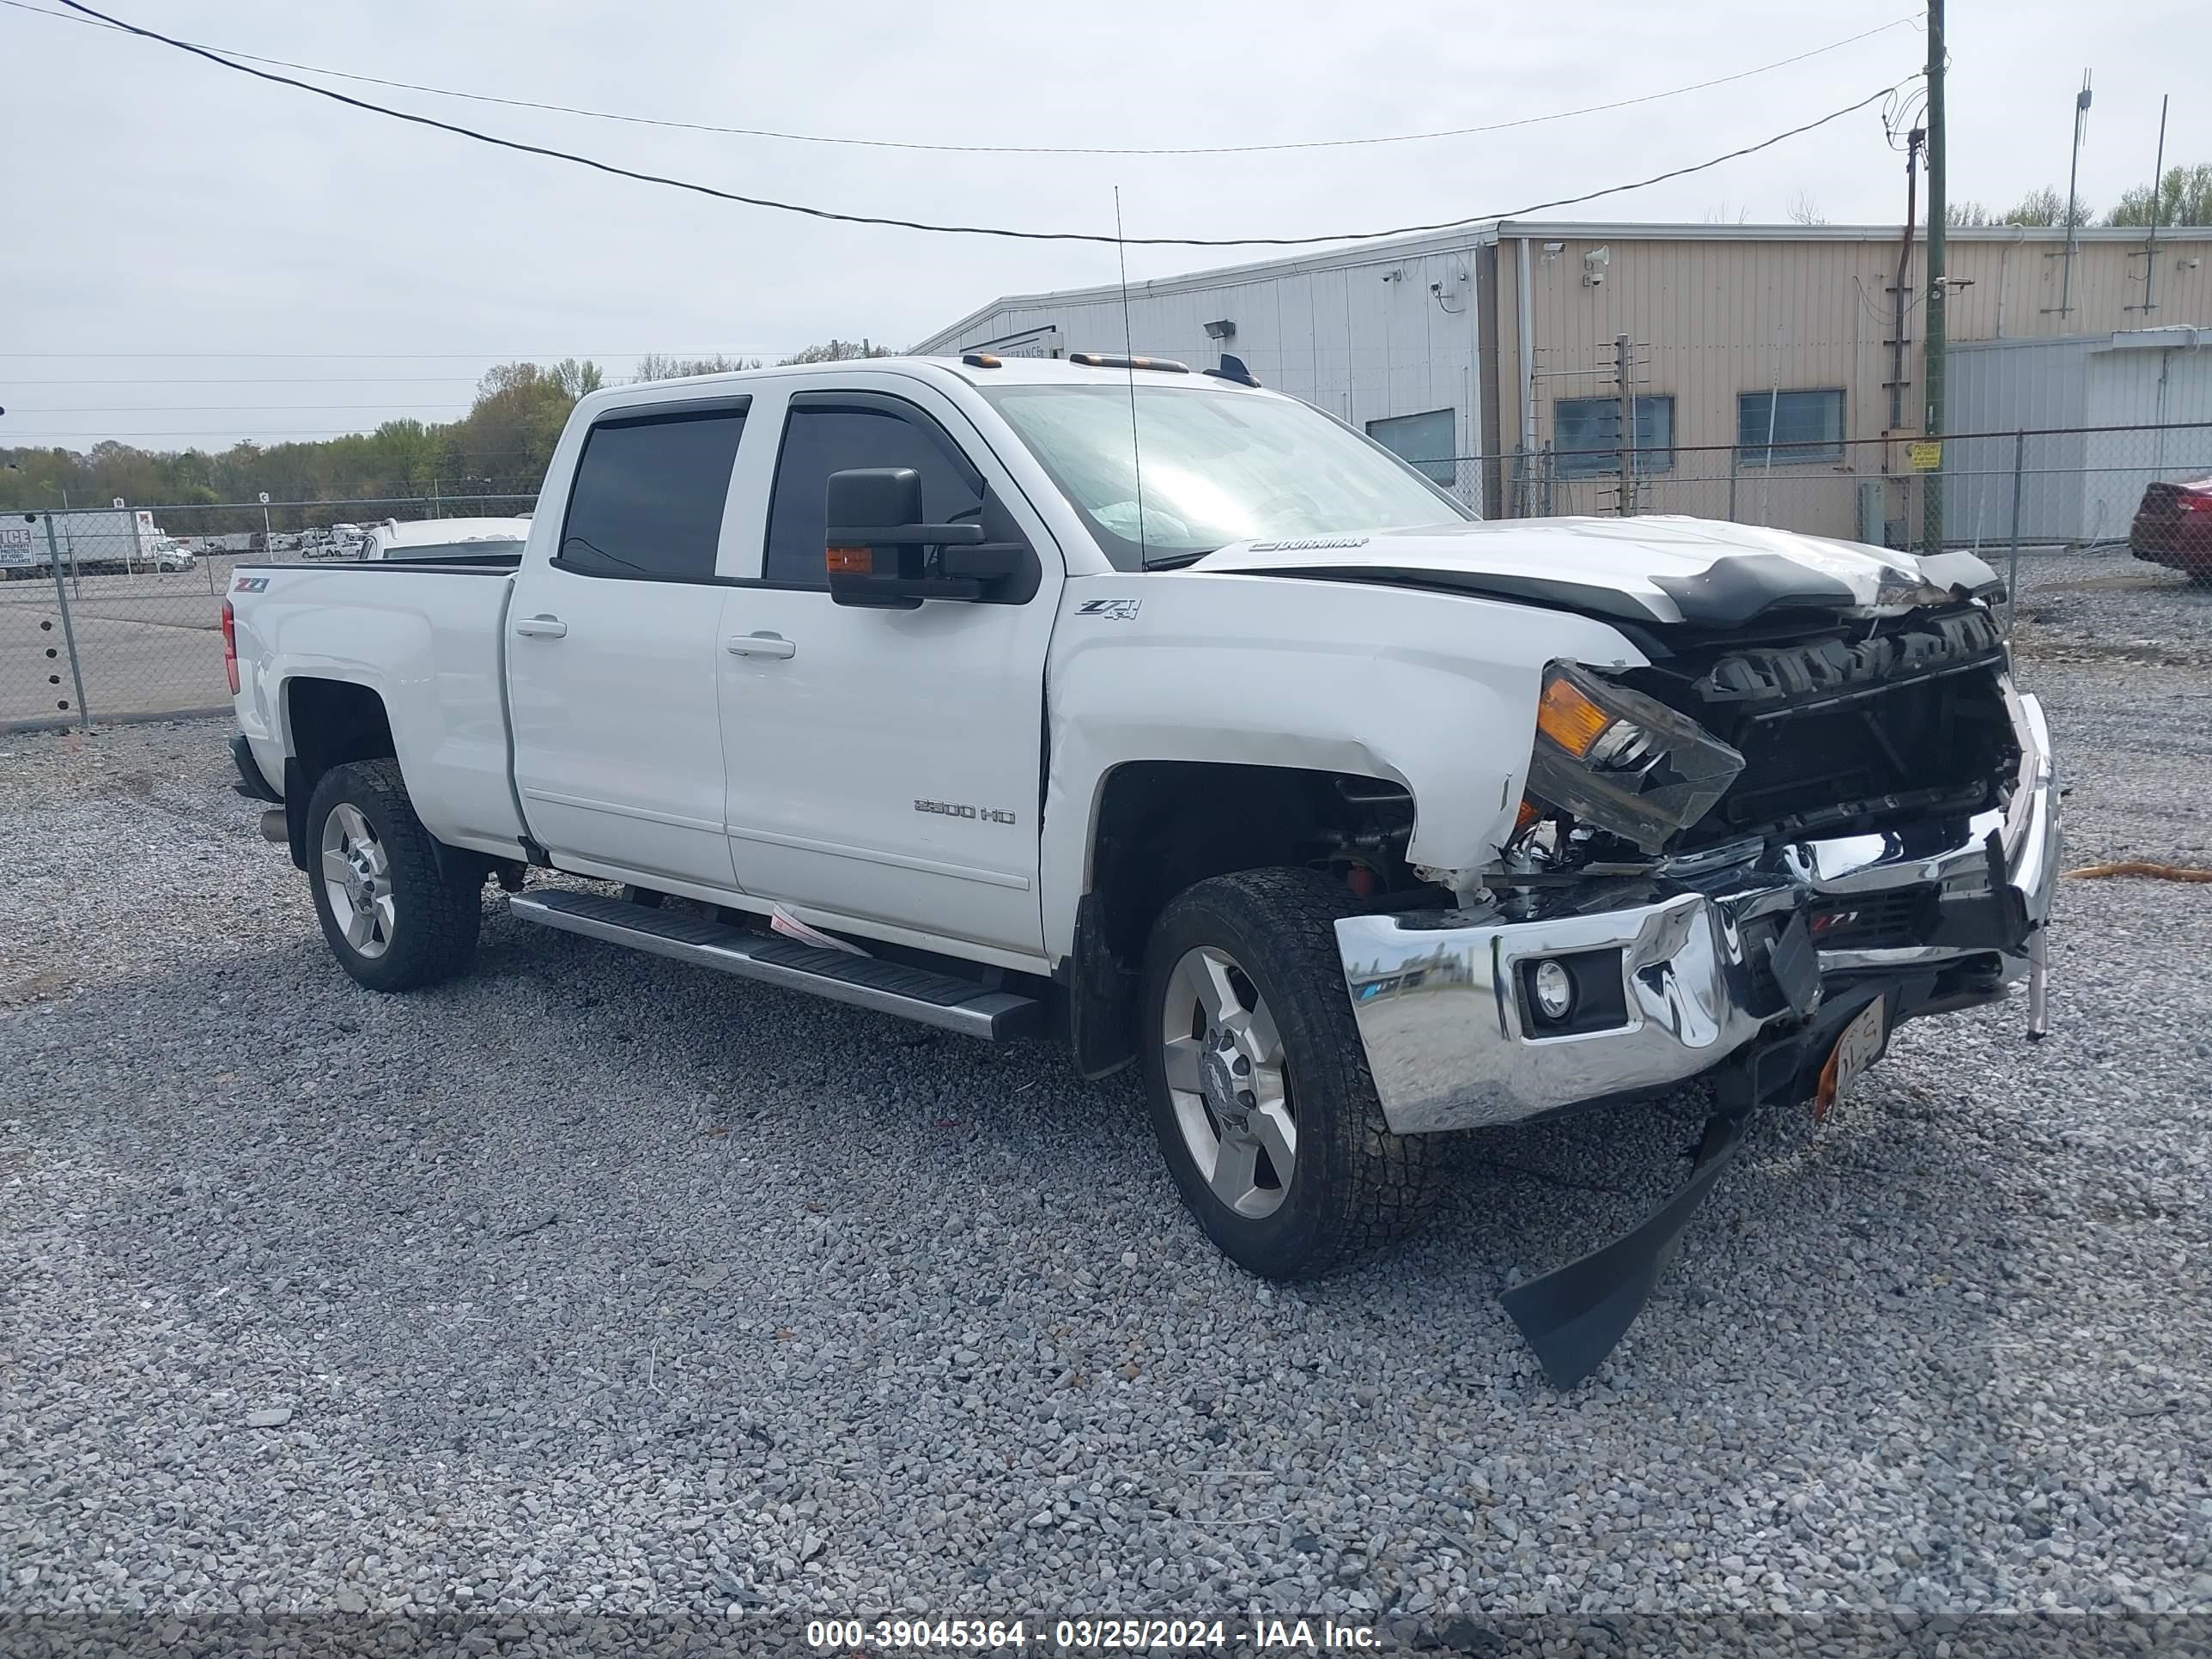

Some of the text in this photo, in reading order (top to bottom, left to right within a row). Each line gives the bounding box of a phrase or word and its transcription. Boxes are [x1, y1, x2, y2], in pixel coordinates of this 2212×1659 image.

[0, 531, 29, 544] ICE
[234, 576, 270, 593] Z71
[1073, 599, 1142, 616] Z71
[914, 797, 1016, 825] 2500 HD
